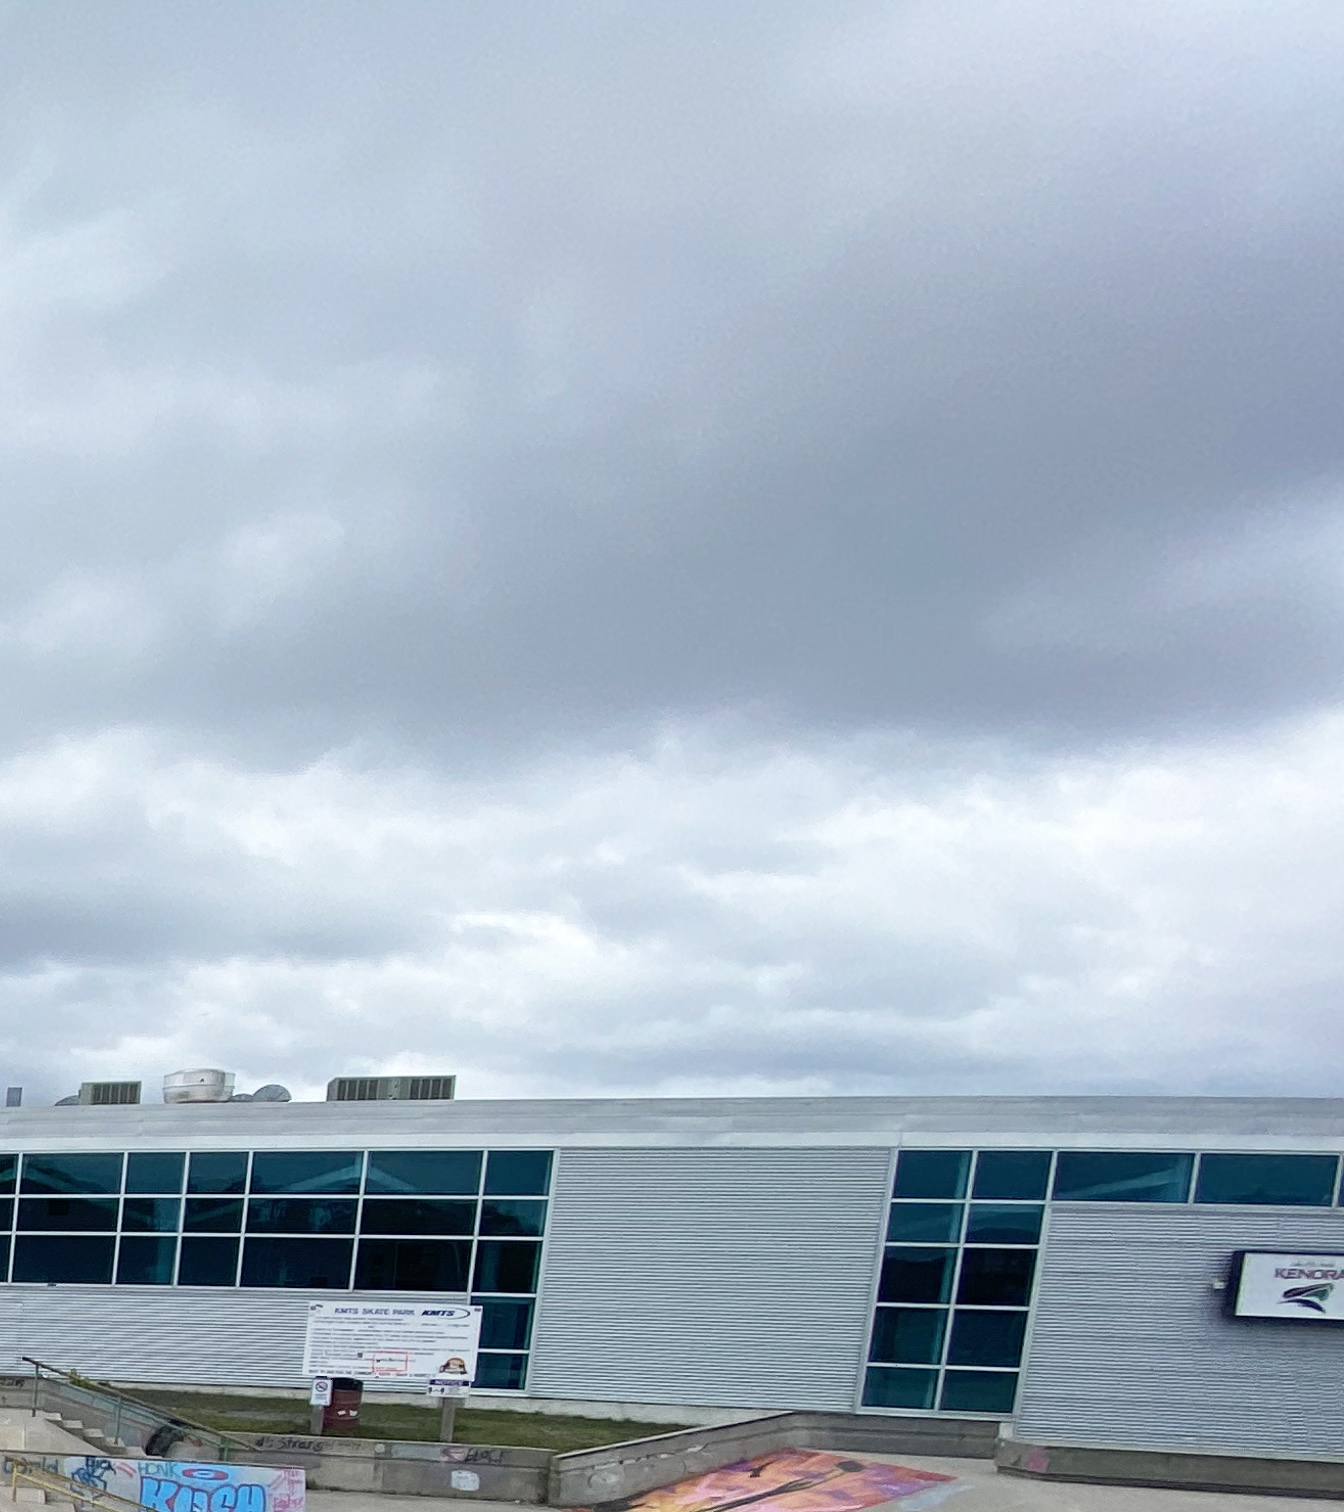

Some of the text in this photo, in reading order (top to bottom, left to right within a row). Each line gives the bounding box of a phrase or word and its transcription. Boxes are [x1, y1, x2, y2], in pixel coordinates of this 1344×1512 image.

[334, 1307, 416, 1316] KMTS SKATE PARK
